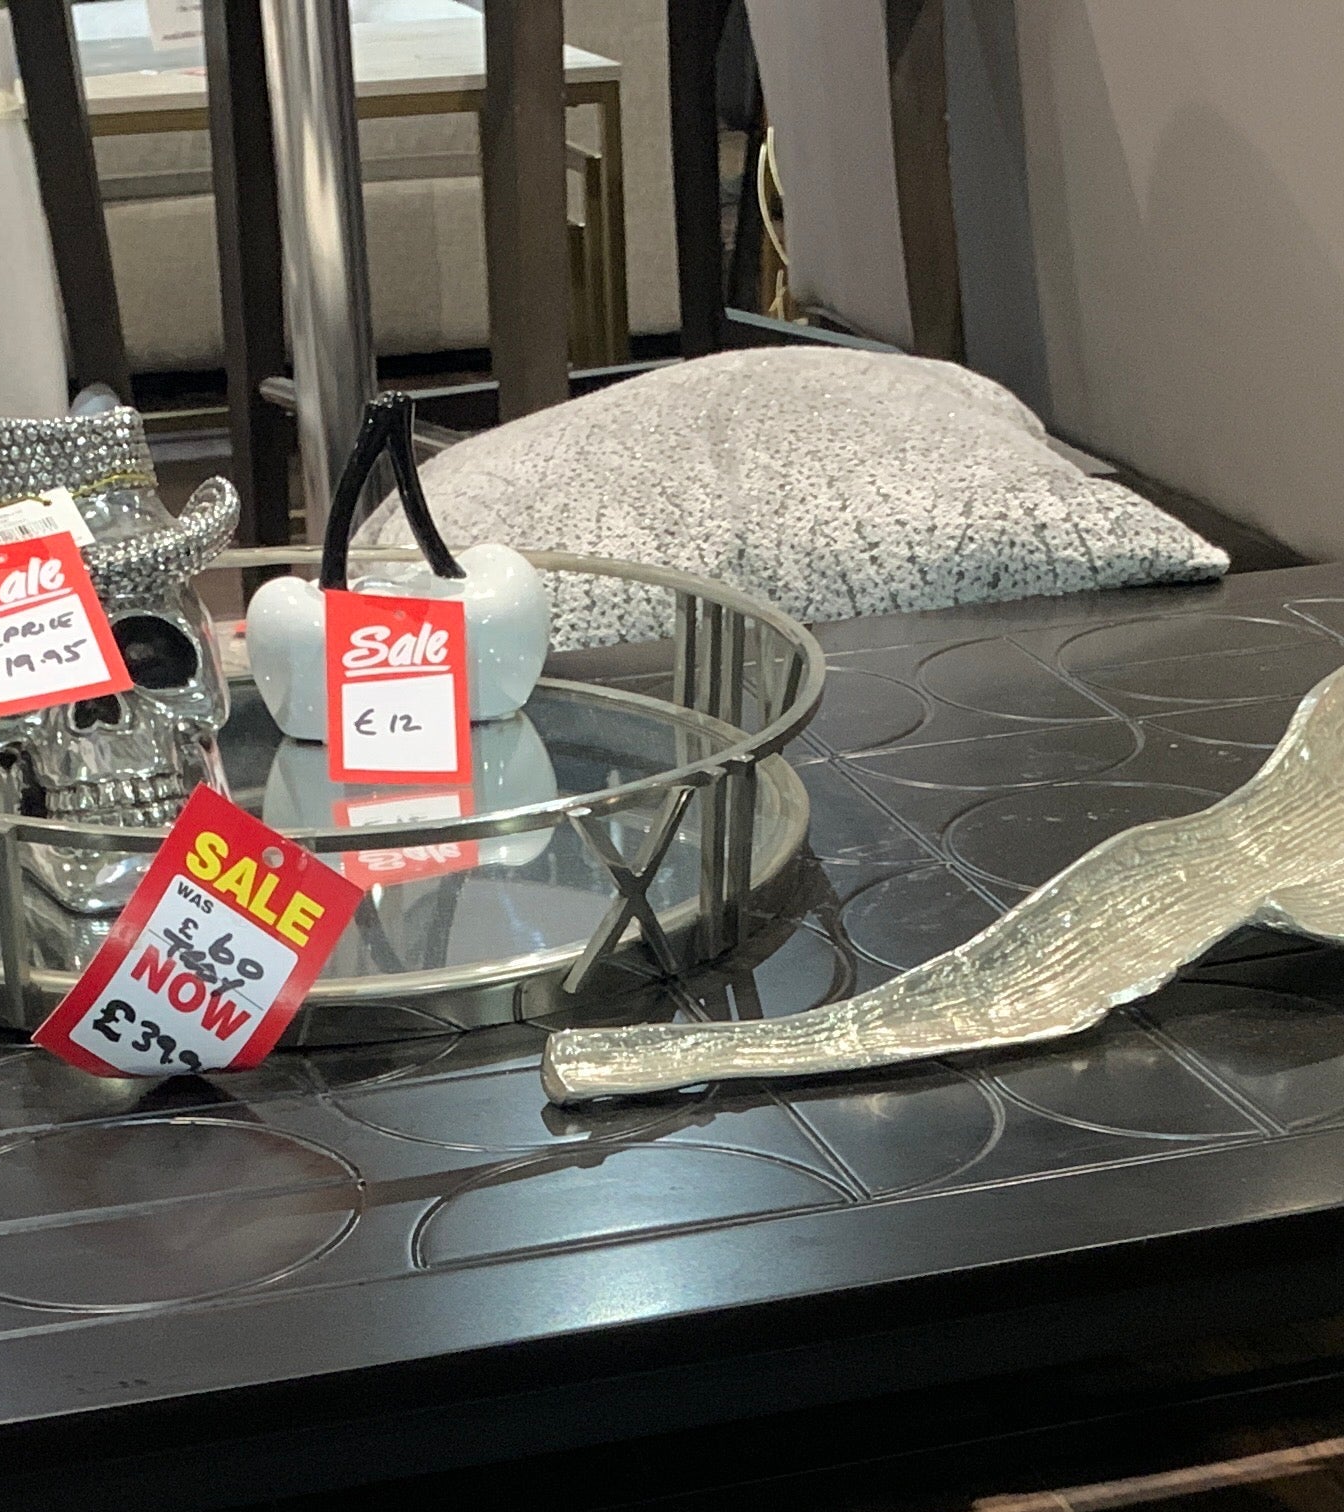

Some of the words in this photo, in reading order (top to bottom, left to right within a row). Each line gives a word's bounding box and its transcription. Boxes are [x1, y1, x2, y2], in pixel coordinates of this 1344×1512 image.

[342, 622, 449, 668] Sale
[176, 881, 214, 914] WAS
[185, 831, 325, 947] SALE
[130, 943, 251, 1041] NOW
